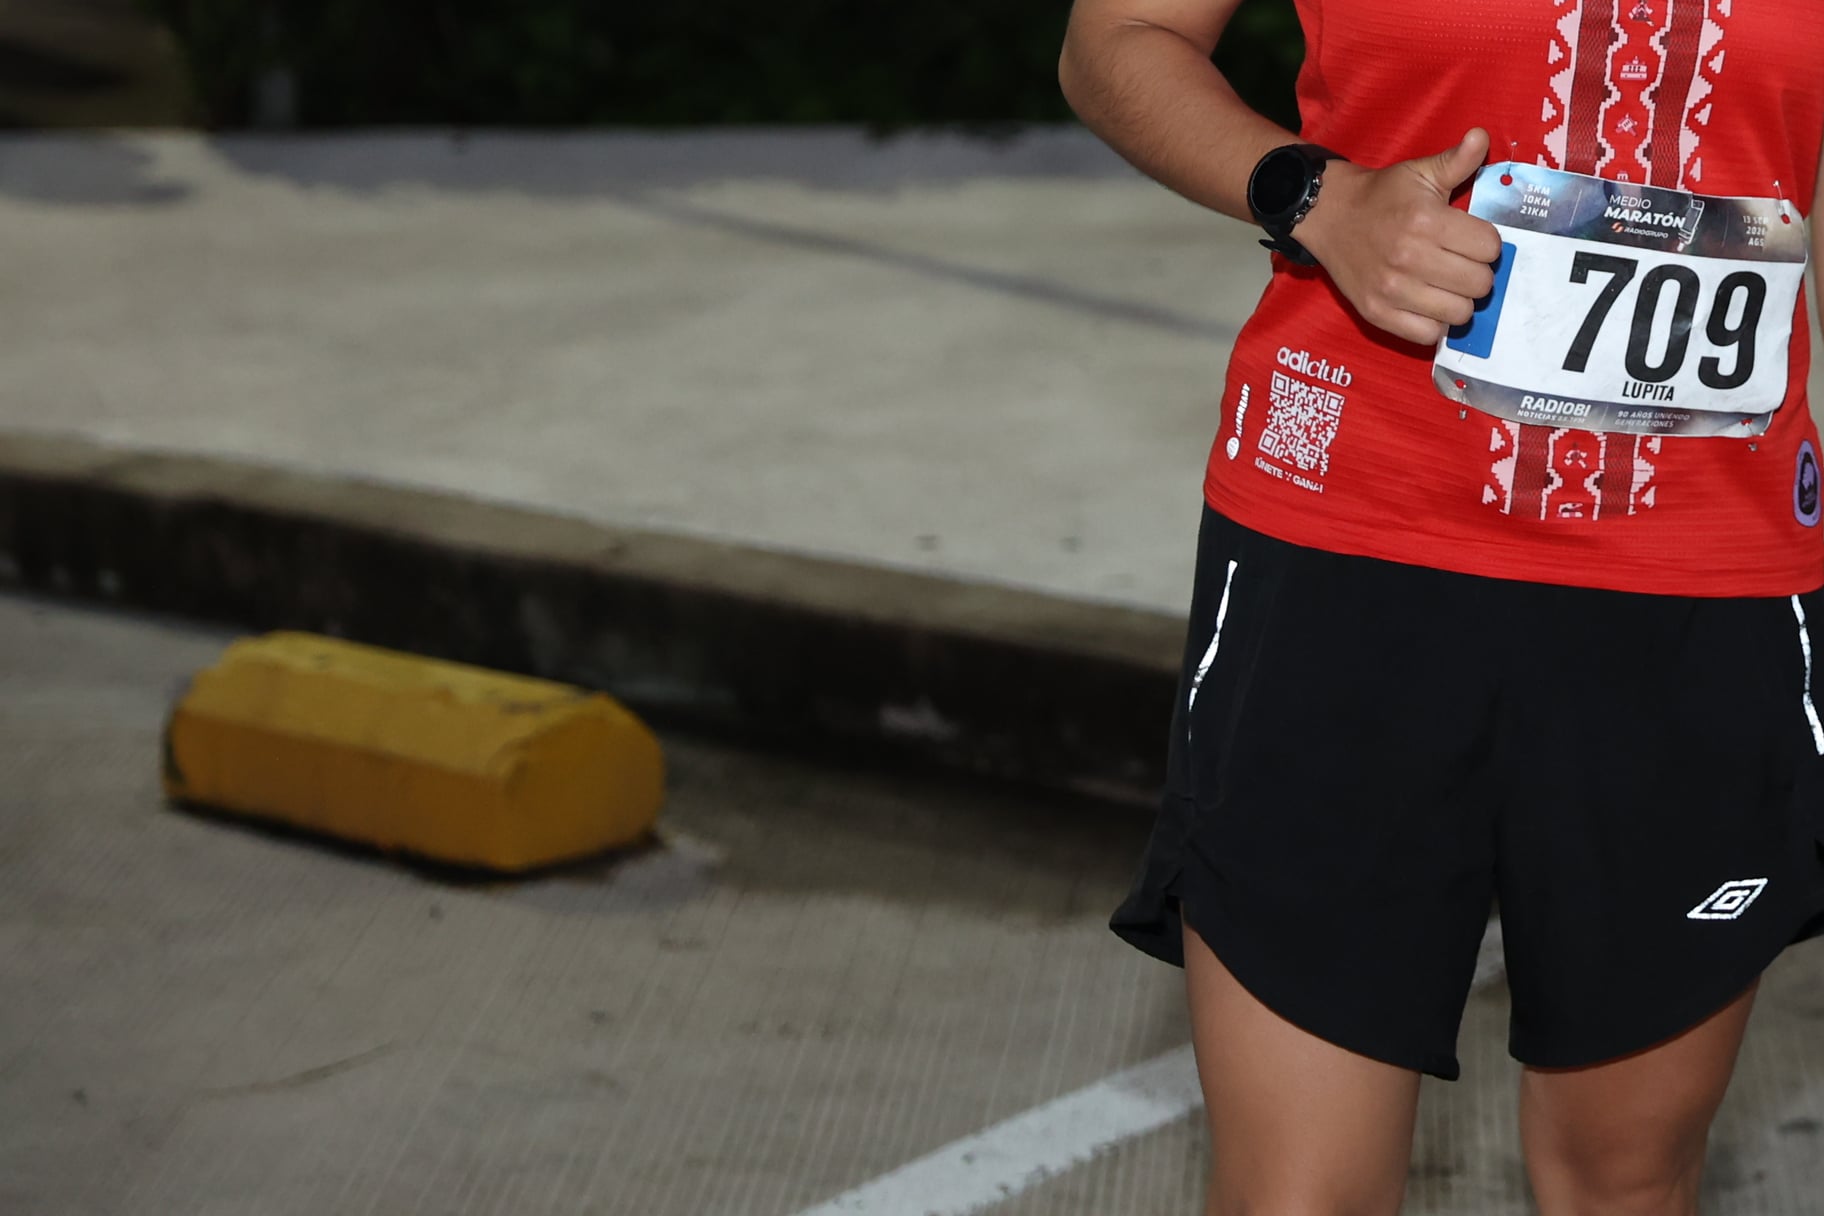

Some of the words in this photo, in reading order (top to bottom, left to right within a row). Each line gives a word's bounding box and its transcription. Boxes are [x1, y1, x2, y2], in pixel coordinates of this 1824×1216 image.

[1527, 184, 1551, 195] 5KM
[1522, 196, 1551, 207] 10KM
[1609, 194, 1652, 209] MEDIO
[1519, 206, 1549, 218] 21KM
[1603, 206, 1687, 229] MARATÓN
[1562, 250, 1767, 390] 709
[1276, 346, 1352, 388] adiclub
[1622, 381, 1675, 401] LUPITA
[1520, 395, 1591, 417] RADIOBI
[1517, 409, 1557, 421] NOTICIAS
